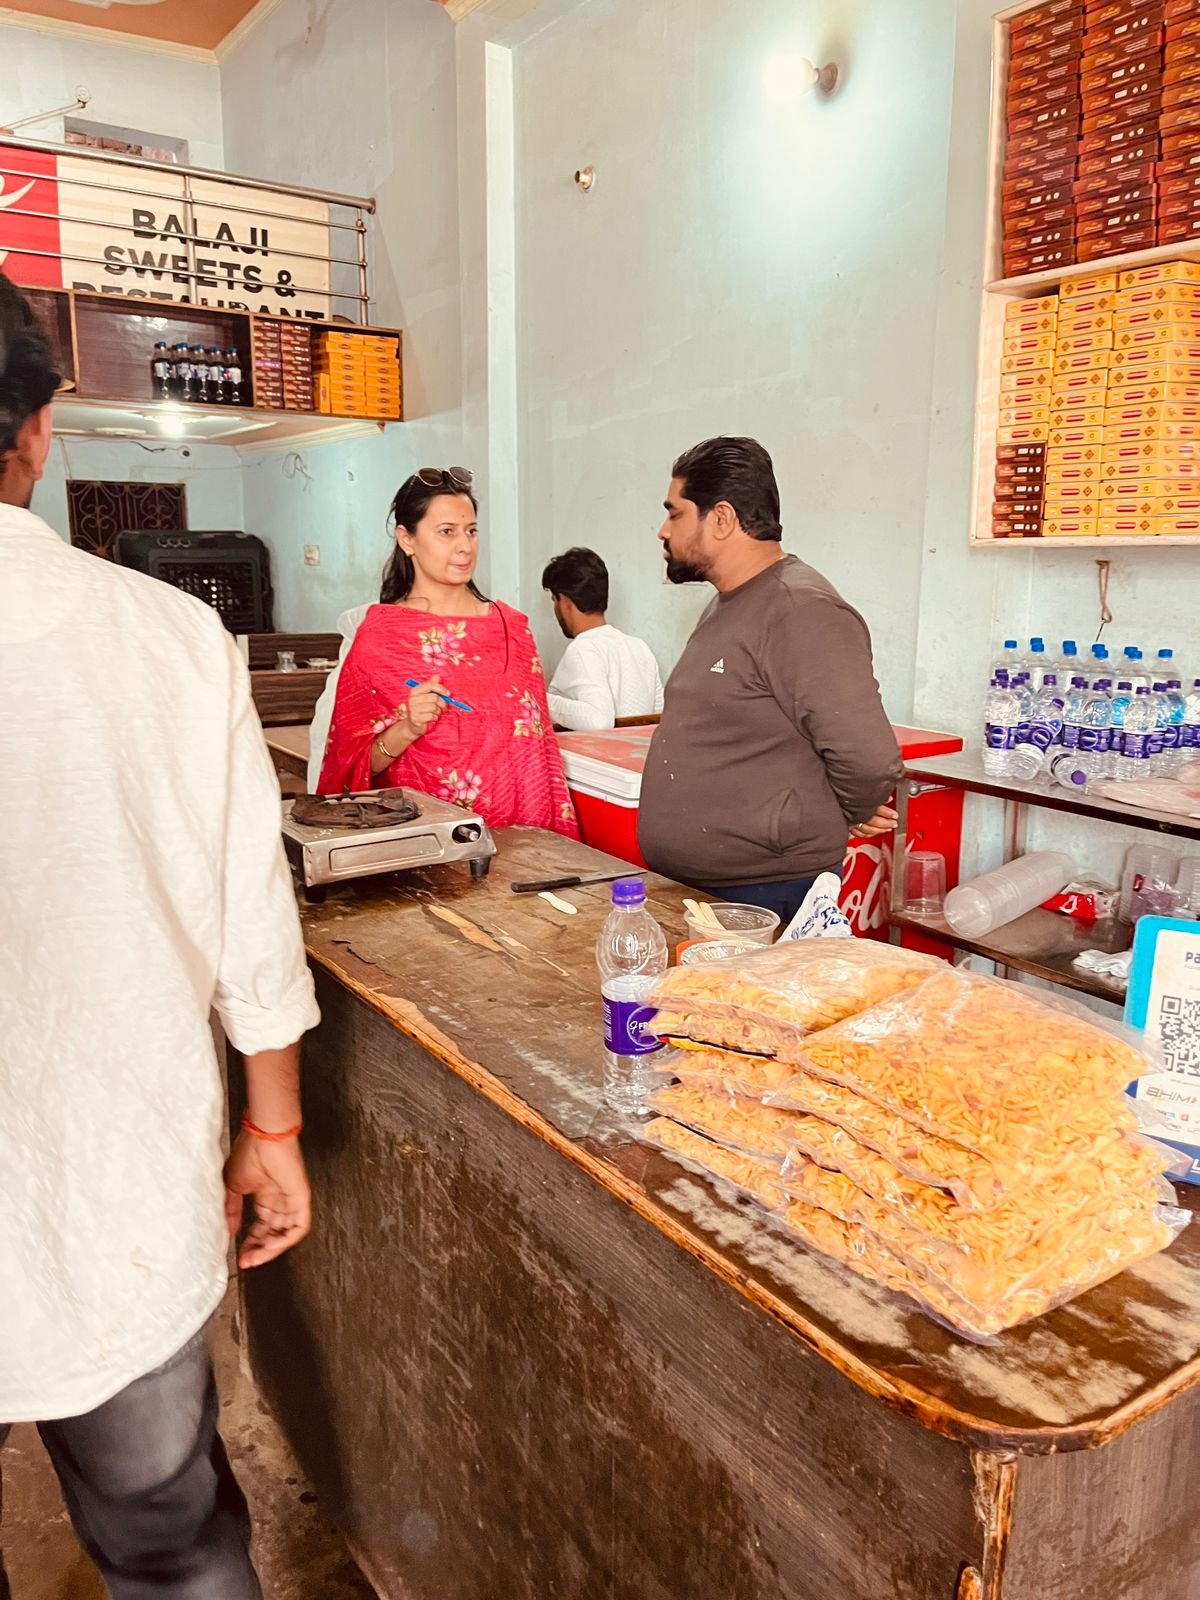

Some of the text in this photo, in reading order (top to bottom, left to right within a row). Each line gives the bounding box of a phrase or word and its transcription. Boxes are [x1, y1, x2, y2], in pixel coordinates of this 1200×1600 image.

[132, 208, 268, 256] BALAJI
[103, 245, 296, 298] SWEETS &
